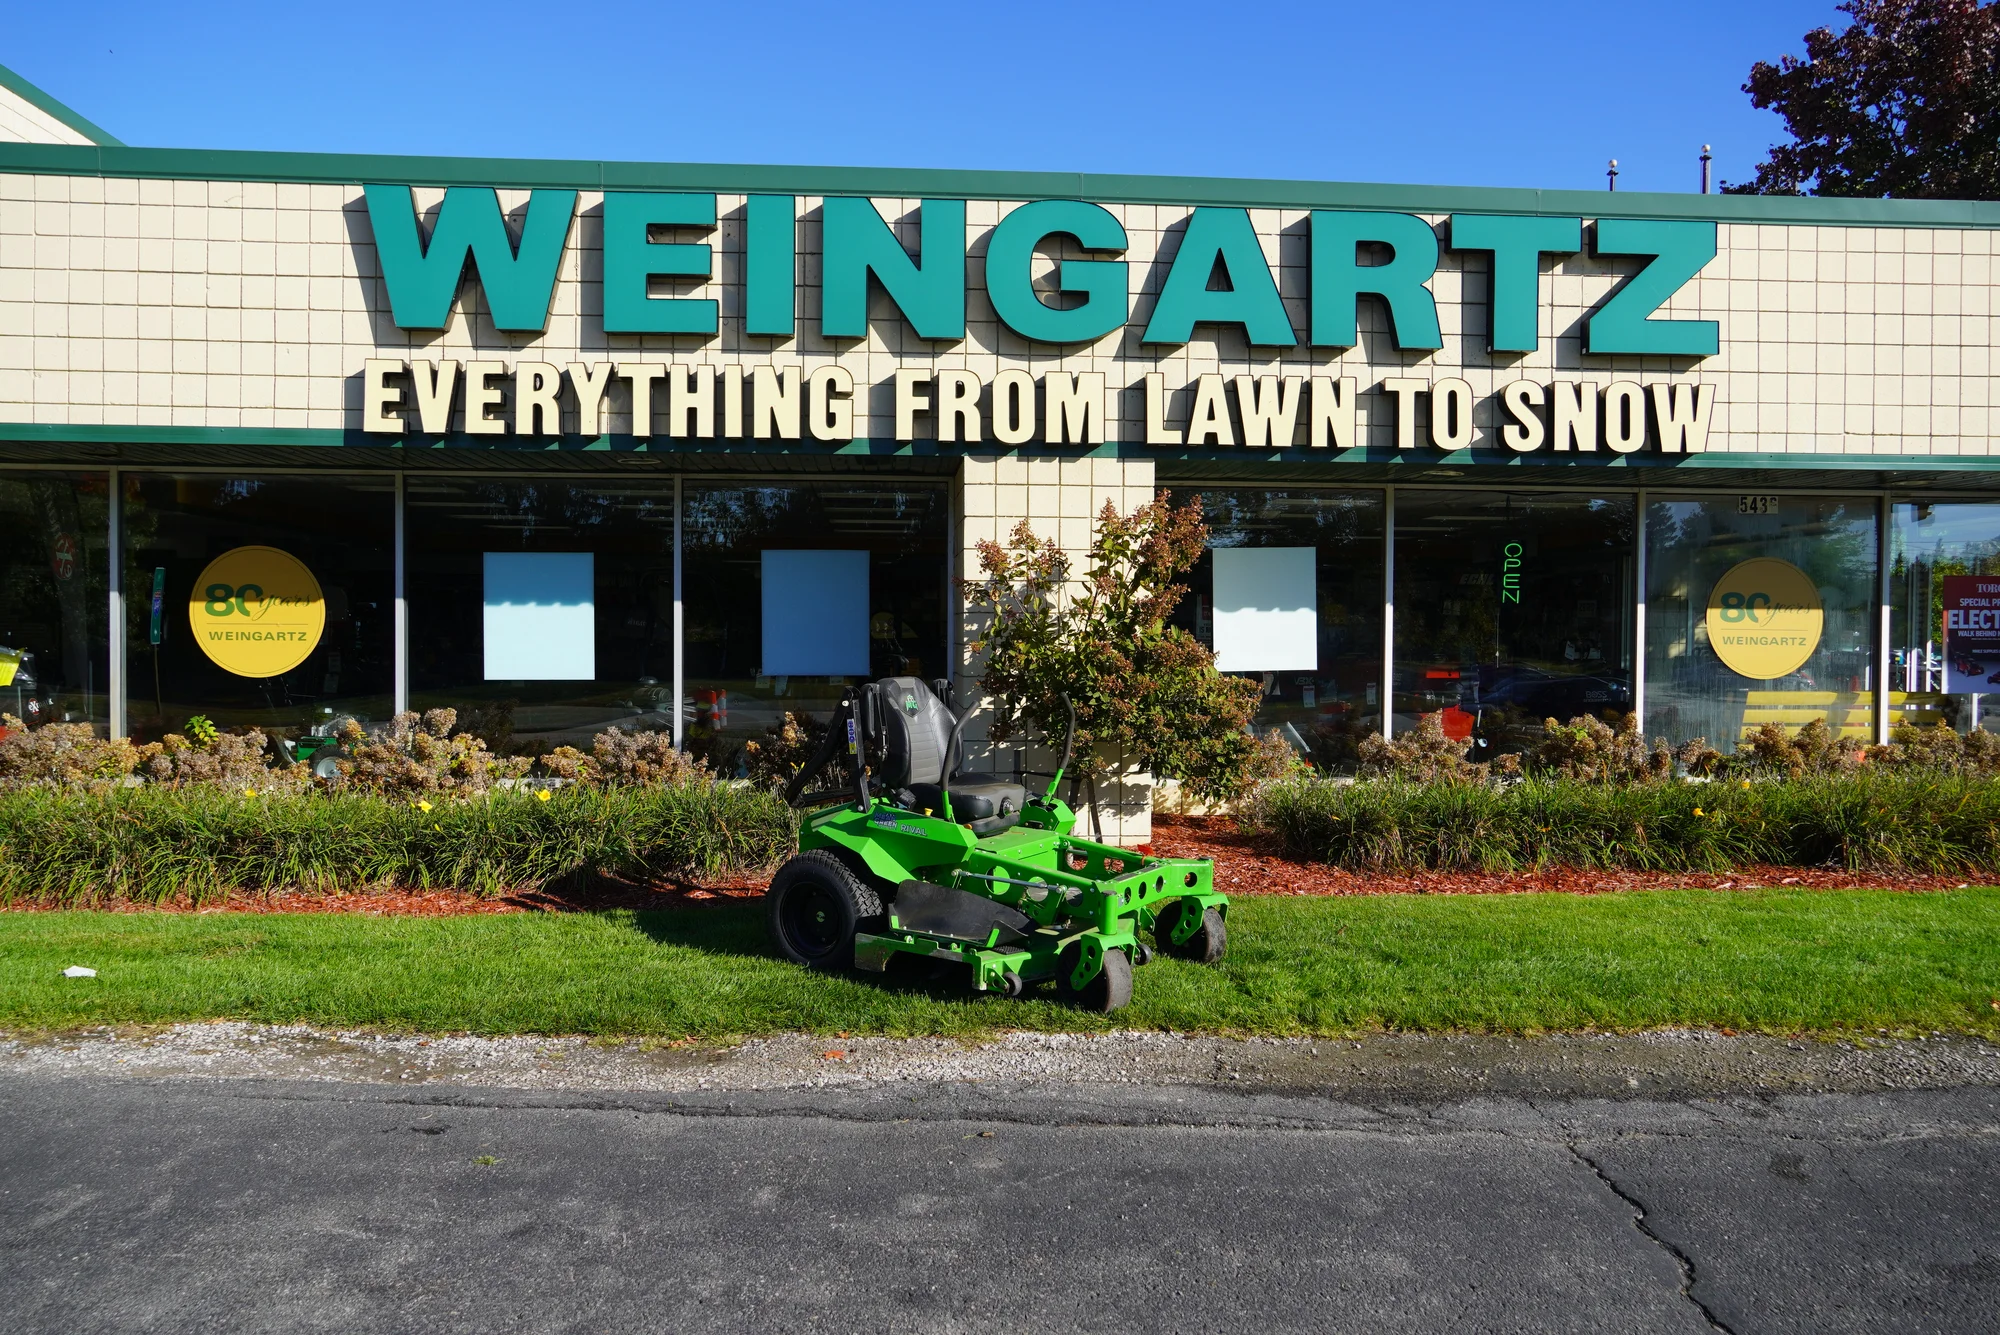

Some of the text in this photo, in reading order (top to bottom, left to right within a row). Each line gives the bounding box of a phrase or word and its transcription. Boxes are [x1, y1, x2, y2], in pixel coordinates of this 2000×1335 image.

[362, 183, 1720, 357] WEINGARTZ
[362, 357, 1716, 455] EVERYTHING FROM LAWN TO SNOW
[1501, 541, 1523, 605] OPEN
[204, 583, 312, 621] 80 years
[1719, 592, 1811, 627] 80 years
[1959, 598, 1990, 607] SPECIAL
[208, 631, 308, 642] WEINGARTZ
[1722, 636, 1807, 646] WEINGARTZ
[900, 823, 928, 837] RIVAL
